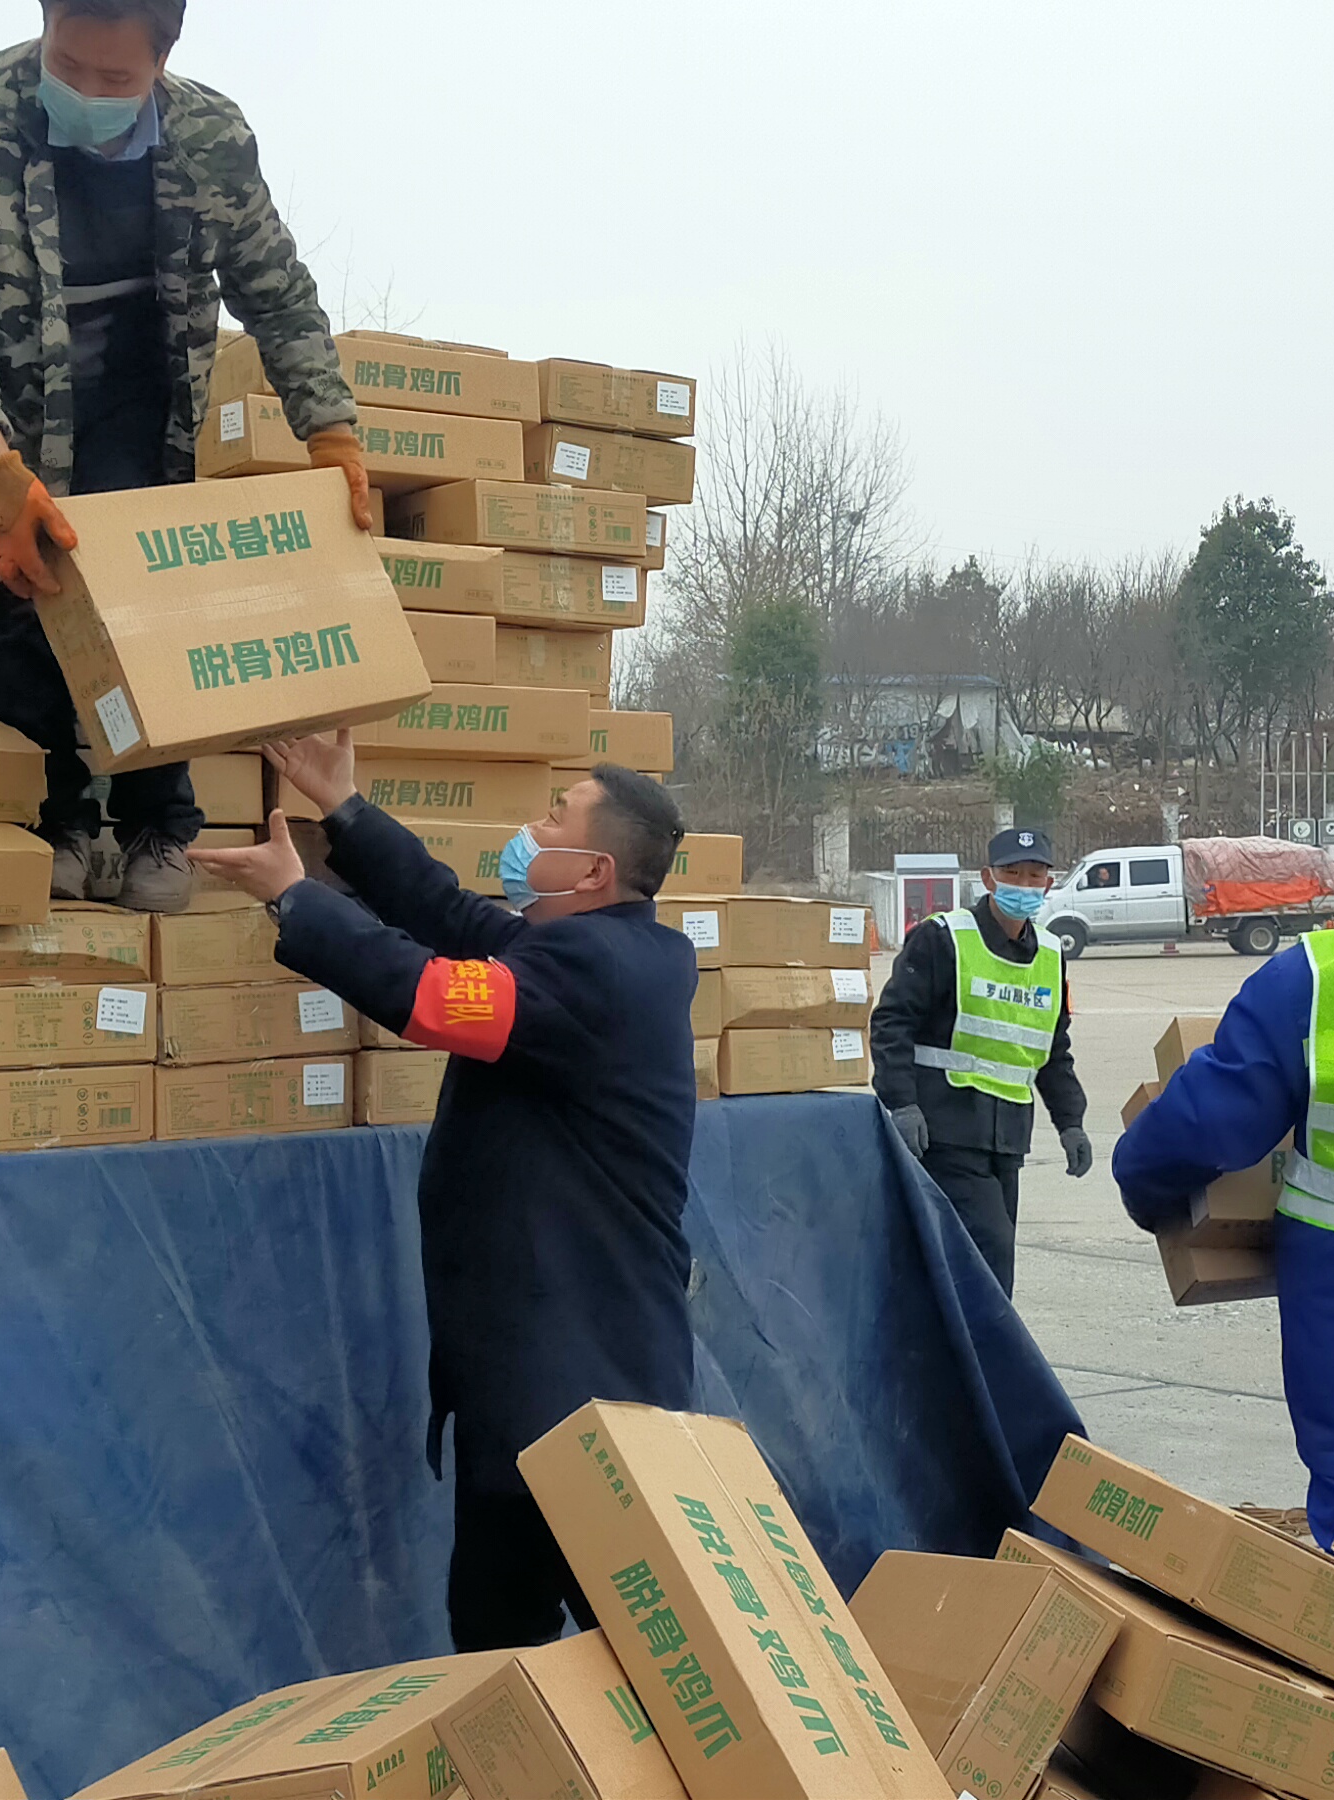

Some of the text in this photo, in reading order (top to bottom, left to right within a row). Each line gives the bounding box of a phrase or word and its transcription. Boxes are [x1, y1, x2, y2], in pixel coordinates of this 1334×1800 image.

[354, 361, 462, 397] 脱骨鸡爪
[136, 510, 312, 573] 脱骨鸡爪
[186, 623, 359, 691] 脱骨鸡爪
[397, 703, 509, 733] 脱骨鸡爪
[368, 779, 475, 807] 脱骨鸡爪
[986, 982, 1045, 1008] 罗山服务区
[1086, 1479, 1164, 1541] 脱骨鸡爪
[674, 1493, 850, 1758] 脱骨鸡爪
[610, 1558, 742, 1760] 脱骨鸡爪
[293, 1672, 449, 1745] 脱骨鸡爪
